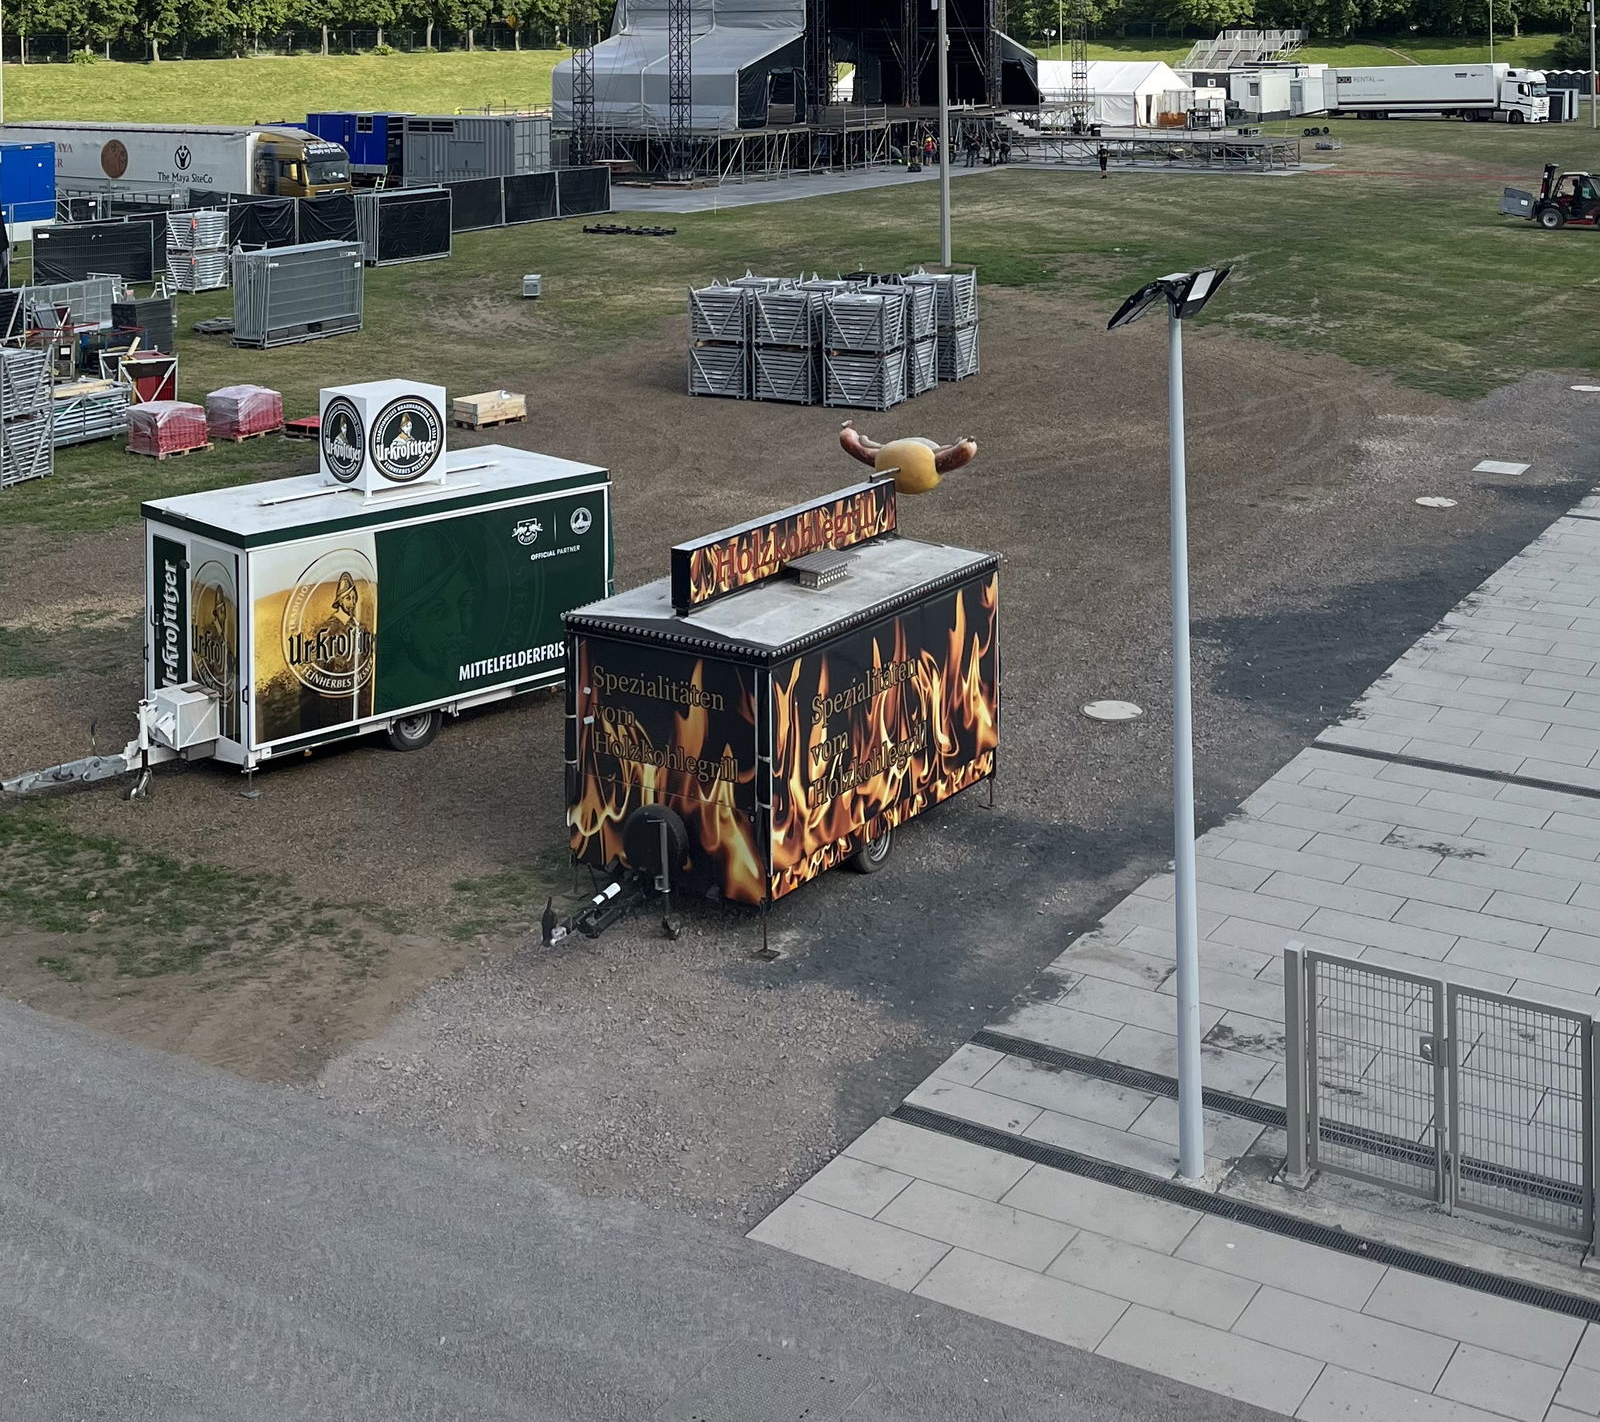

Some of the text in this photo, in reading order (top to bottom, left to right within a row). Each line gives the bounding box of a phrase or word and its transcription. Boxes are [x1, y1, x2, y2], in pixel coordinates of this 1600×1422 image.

[157, 171, 213, 184] The Maya SiteCo
[530, 544, 581, 561] OFFICIAL PARTNER
[715, 488, 877, 582] Holzkohlegrill
[301, 667, 352, 688] FEINHERBES
[459, 640, 565, 682] MITTELFELDERFRIS
[592, 664, 726, 712] Spezialitäten
[811, 657, 918, 729] Spezialitäten
[592, 703, 636, 727] vom
[593, 730, 741, 784] Holzkohlegrill
[810, 730, 850, 766] vom
[811, 719, 929, 809] Holzkohlegrill
